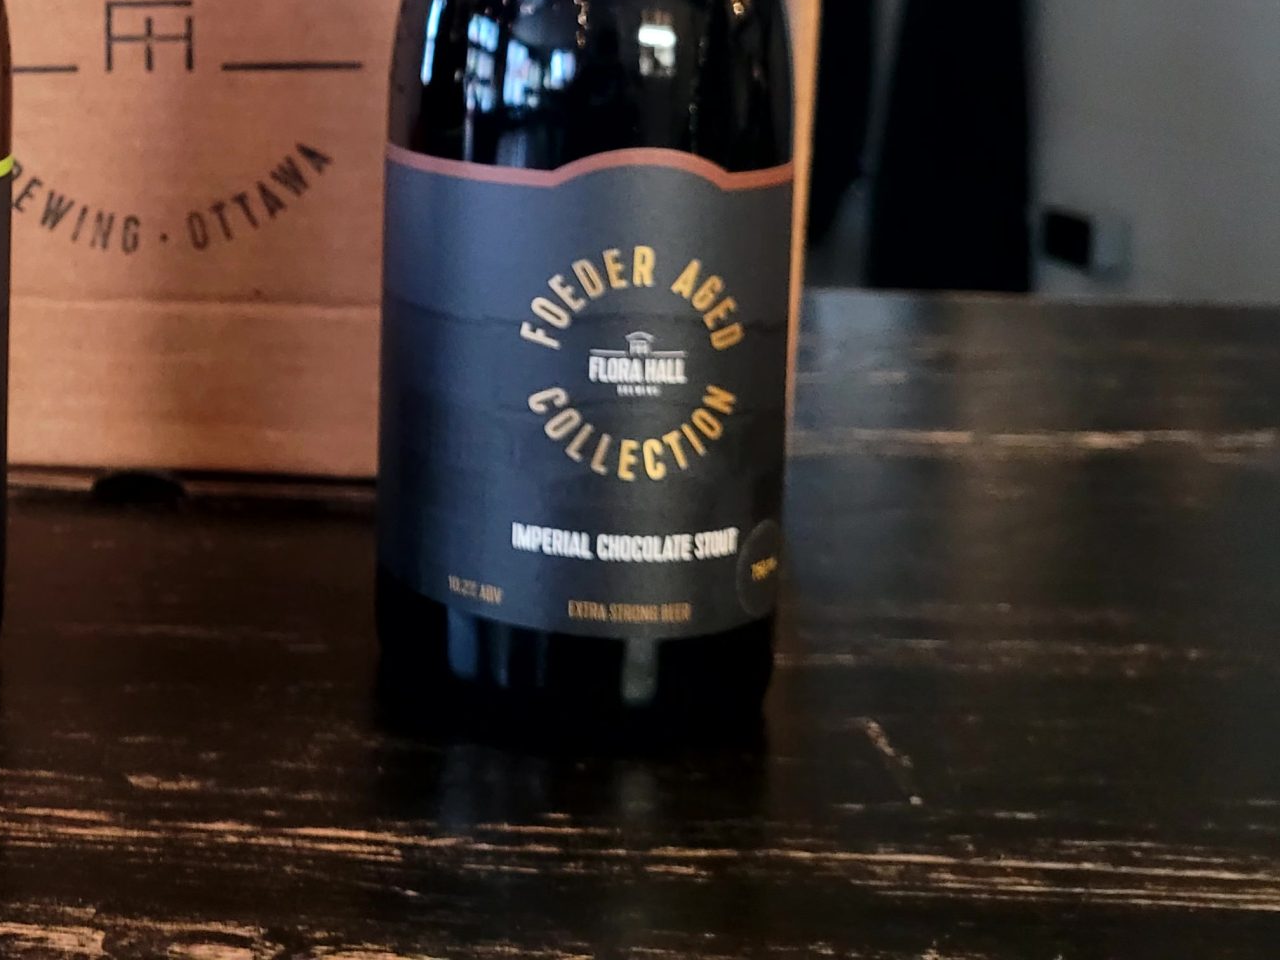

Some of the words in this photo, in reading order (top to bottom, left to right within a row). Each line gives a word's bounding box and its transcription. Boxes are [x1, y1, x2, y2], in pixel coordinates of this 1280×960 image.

[12, 159, 141, 255] EWING
[186, 142, 332, 250] OTTAWA
[520, 245, 656, 350] FOEDER
[671, 258, 746, 351] AGED
[589, 356, 644, 384] FLORA
[644, 358, 688, 384] HALL
[528, 386, 737, 482] COLLECTION
[512, 522, 593, 560] IMPERIAL
[596, 533, 693, 563] CHOCOLATE
[693, 526, 739, 560] STOUT
[568, 599, 607, 621] EXTRA
